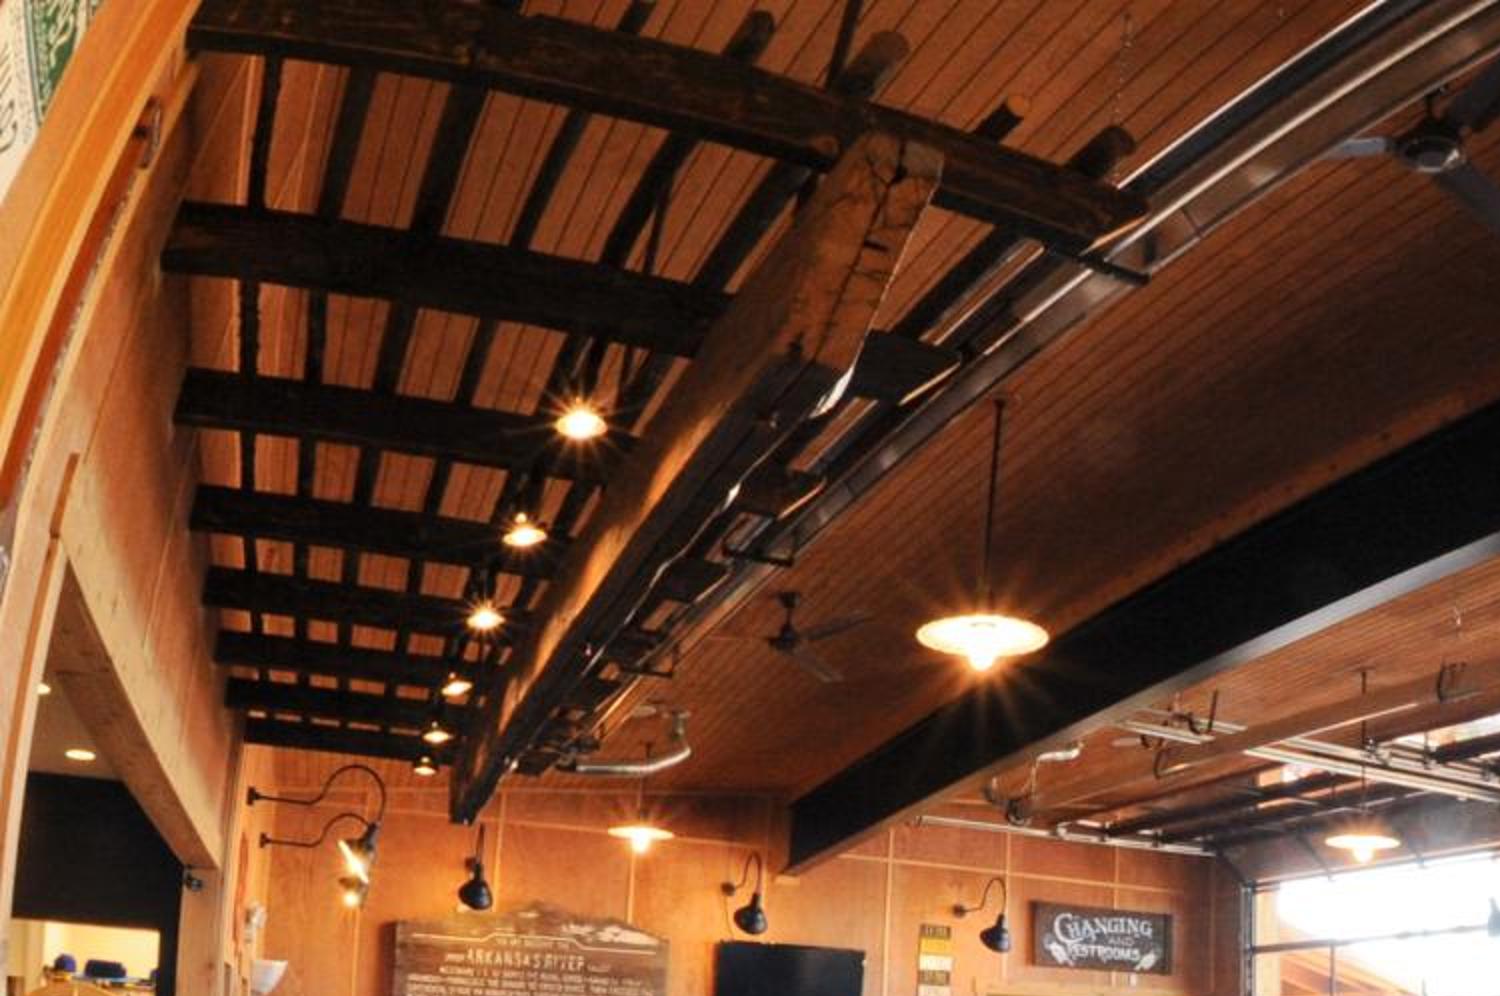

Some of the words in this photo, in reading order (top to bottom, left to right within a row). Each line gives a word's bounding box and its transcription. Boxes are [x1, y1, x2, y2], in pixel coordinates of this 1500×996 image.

[1054, 912, 1153, 943] CHANGING
[467, 948, 541, 969] ARKANSAS
[1067, 943, 1142, 963] RESTROOMS
